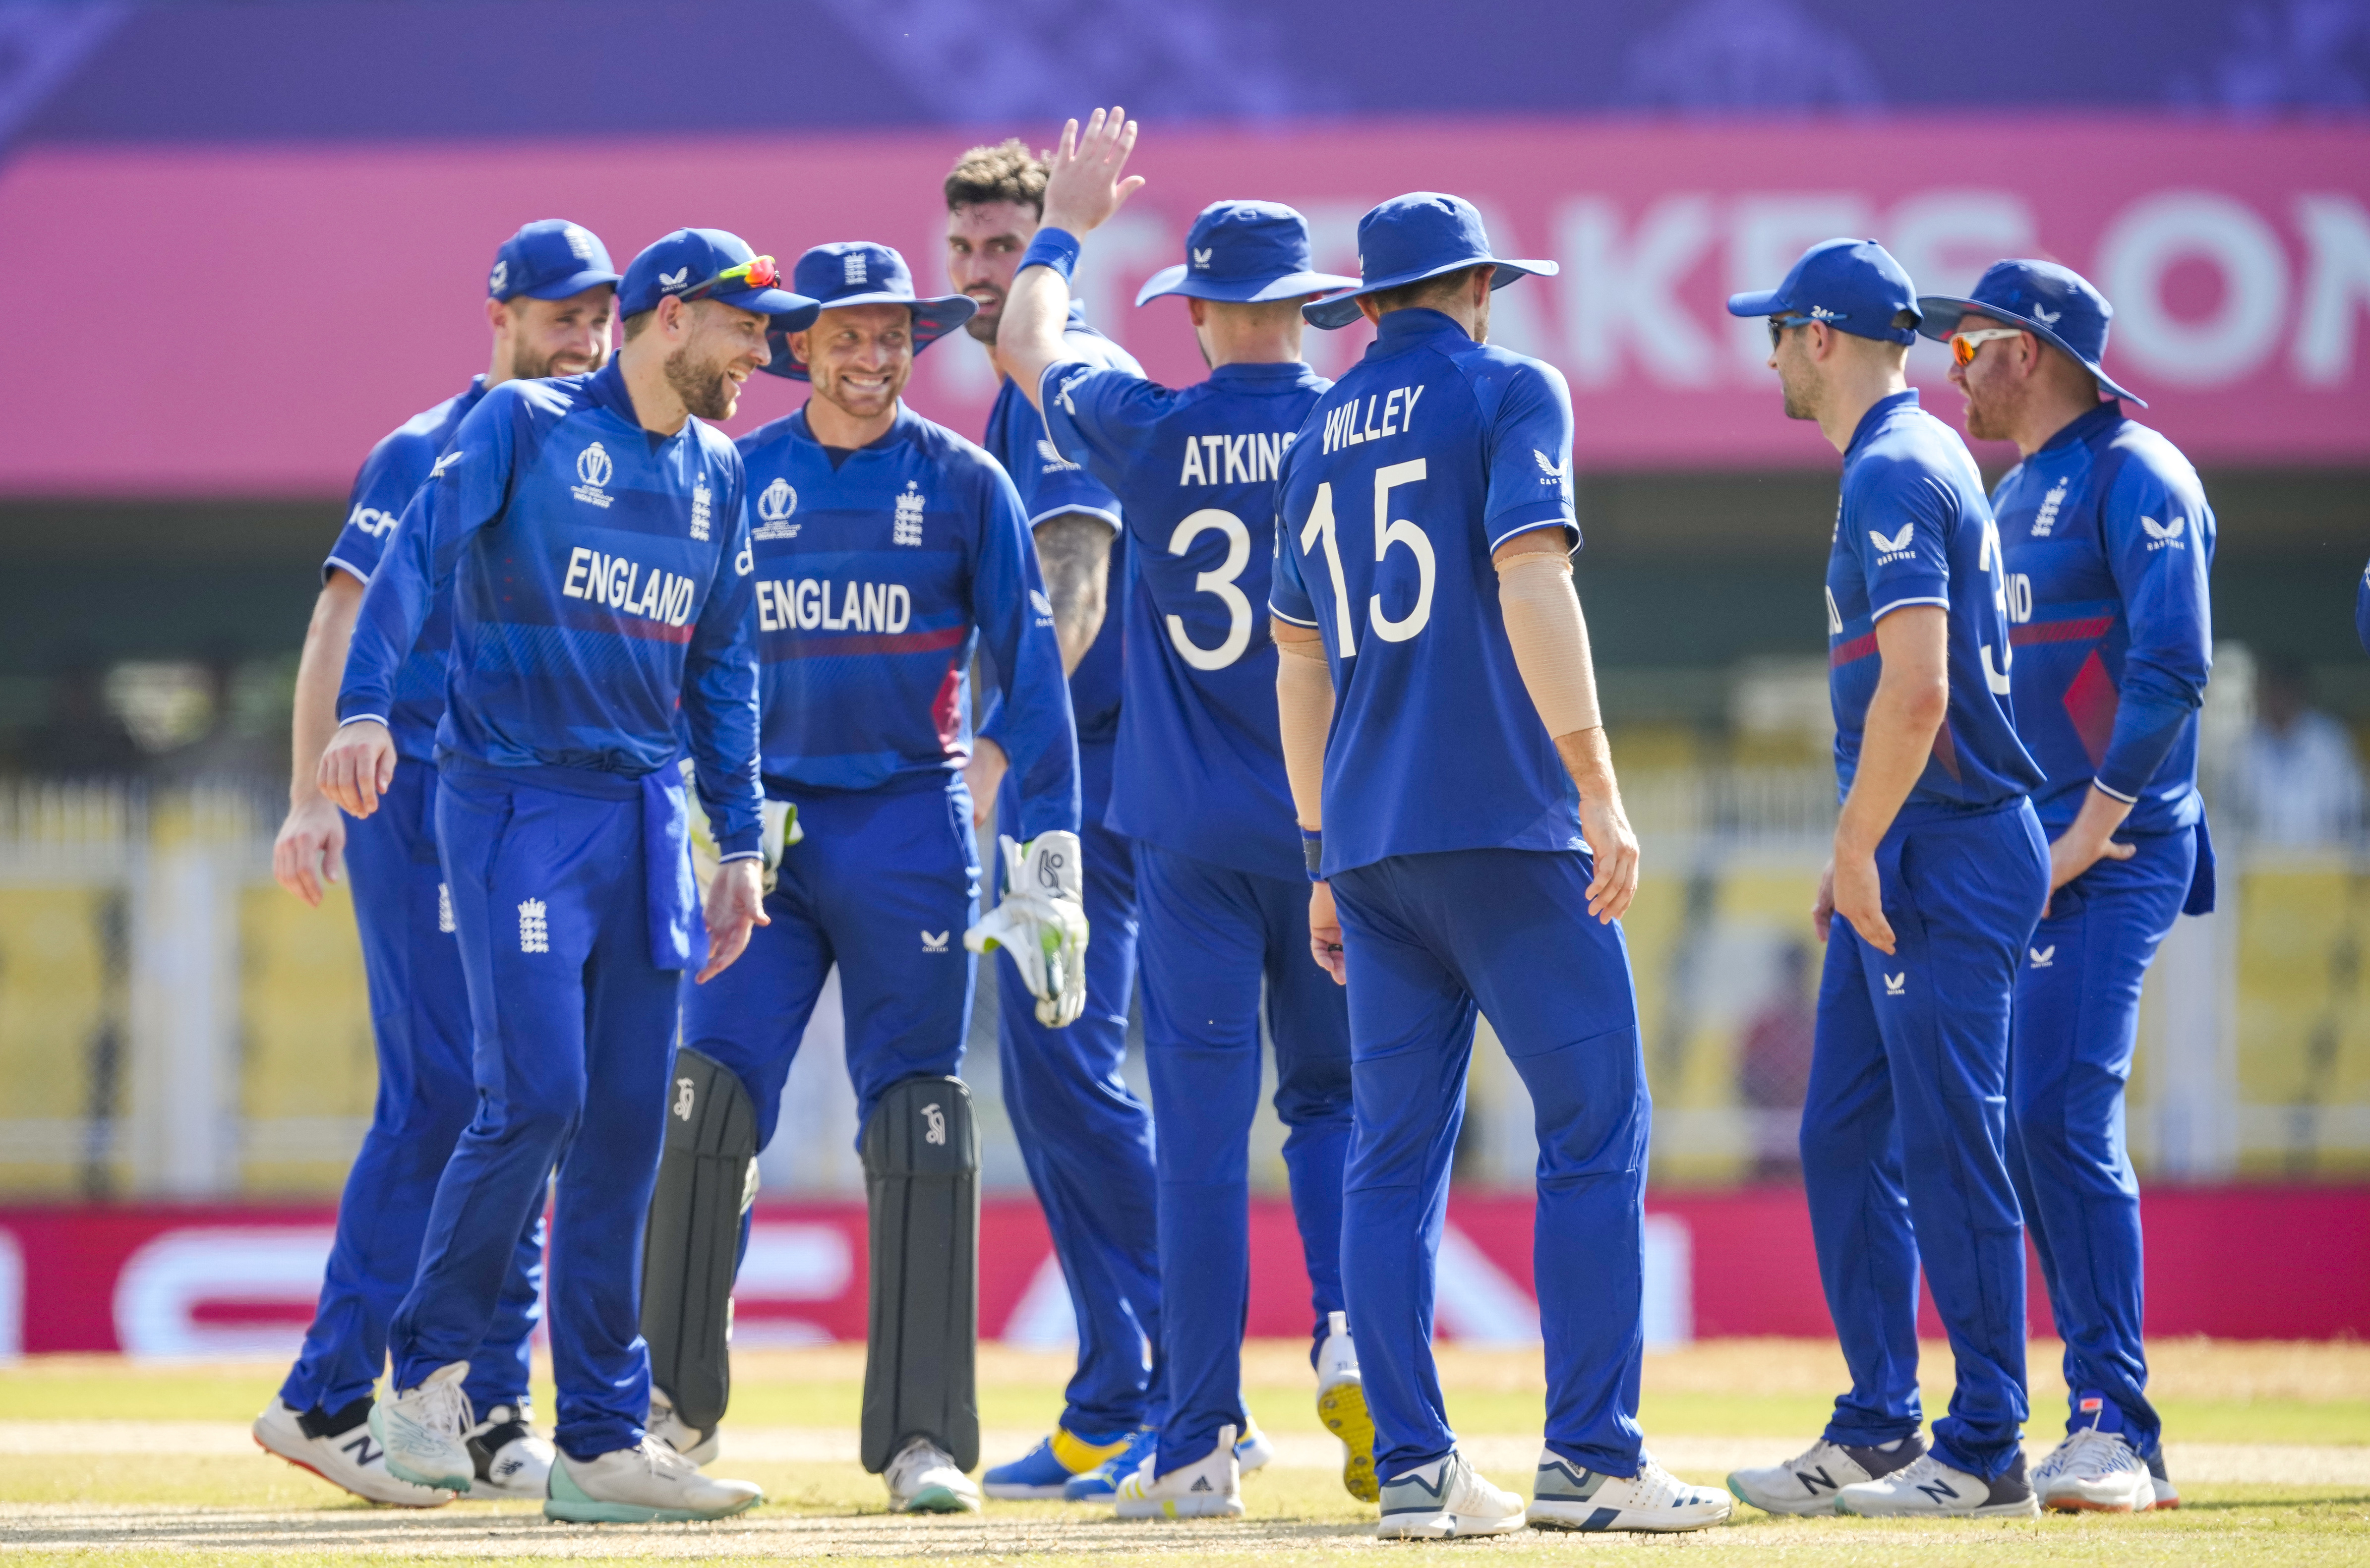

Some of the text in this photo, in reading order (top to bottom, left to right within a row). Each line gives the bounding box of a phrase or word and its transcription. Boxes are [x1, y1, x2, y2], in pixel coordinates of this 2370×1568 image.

[1323, 385, 1424, 455] WILLEY
[1179, 431, 1299, 486] ATKIN
[562, 546, 696, 628] ENGLAND
[1166, 508, 1253, 671] 3
[1300, 457, 1436, 658] 15
[755, 579, 911, 634] ENGLAND
